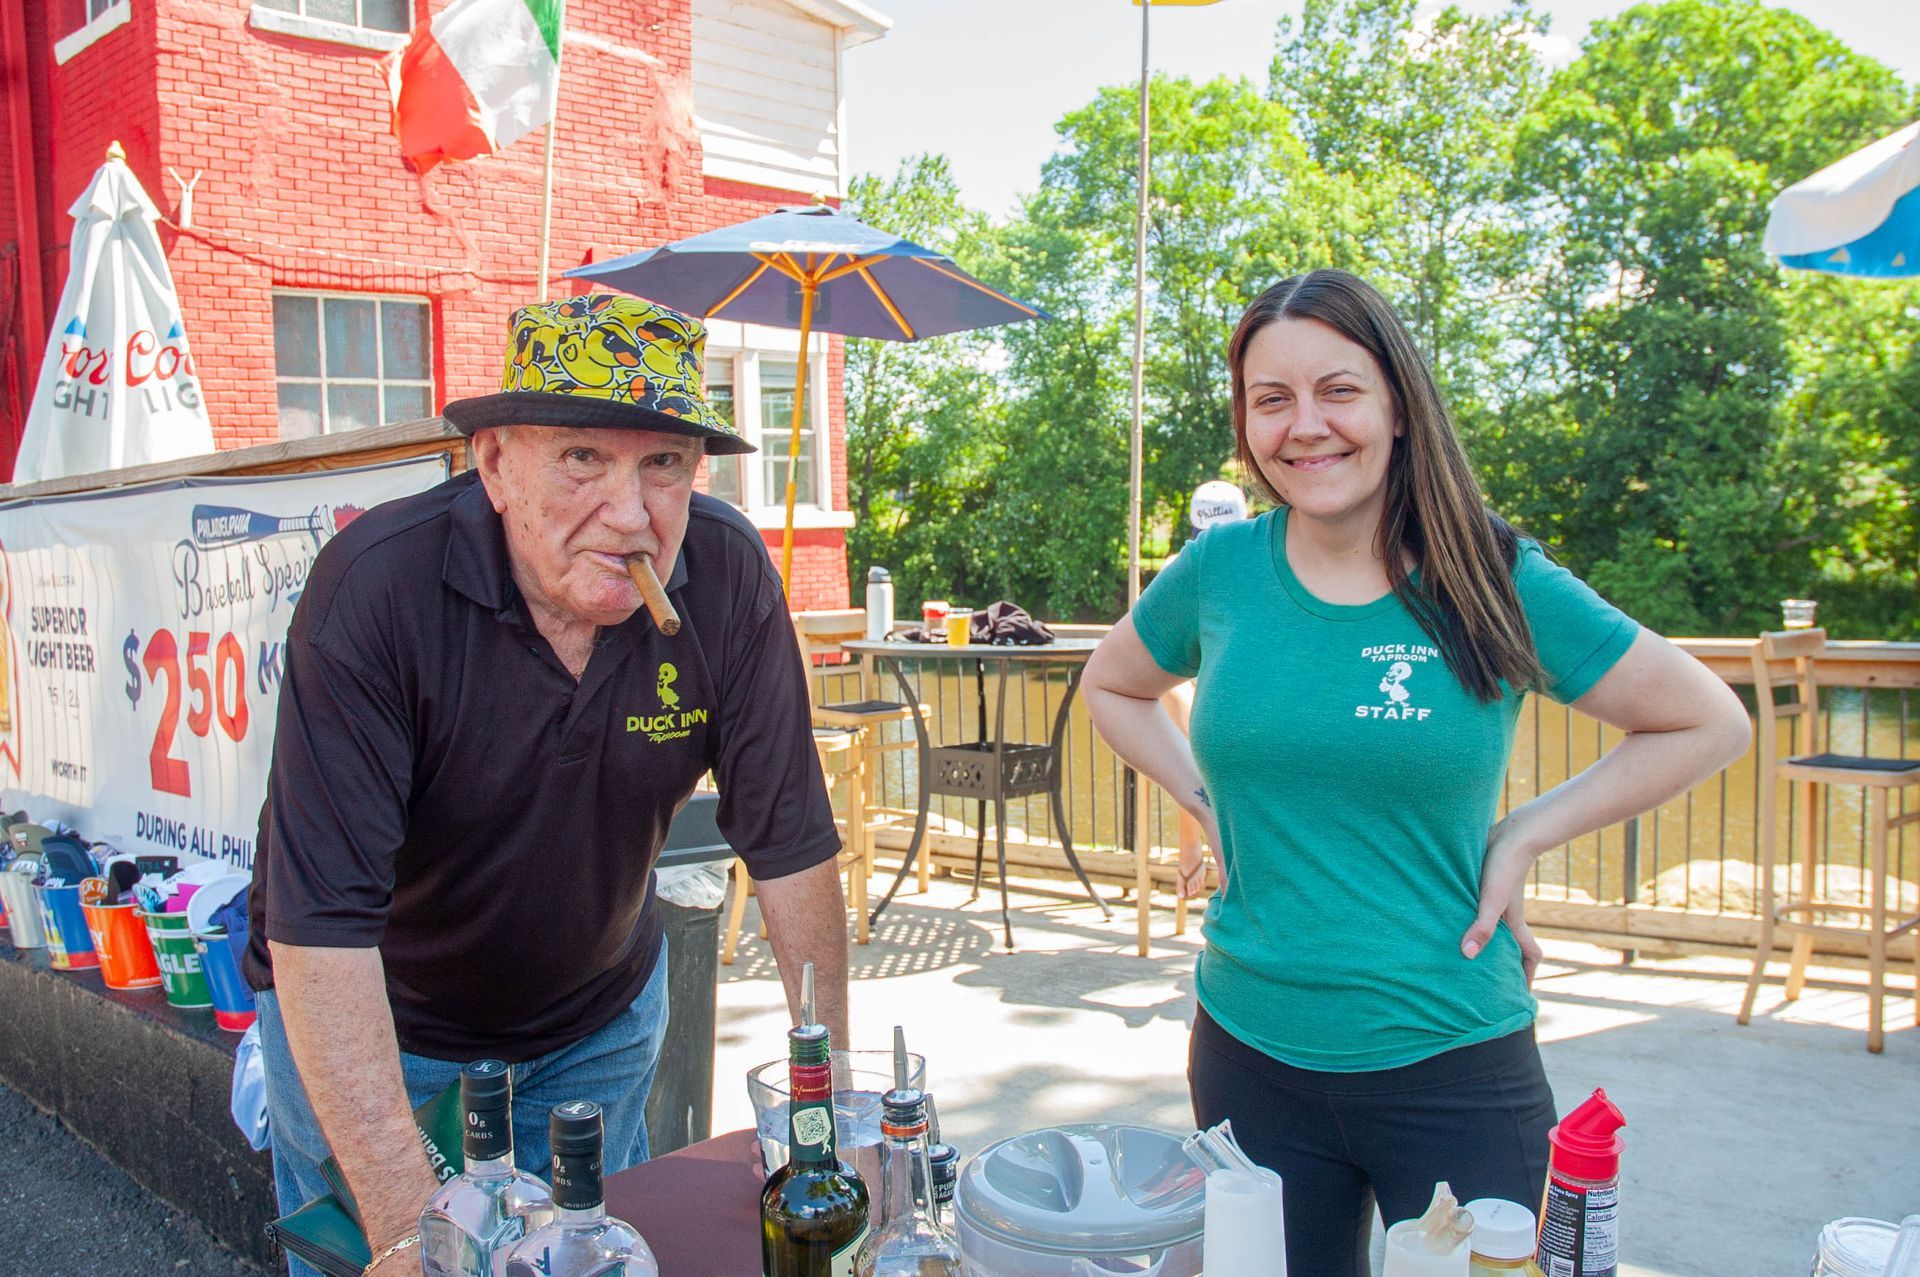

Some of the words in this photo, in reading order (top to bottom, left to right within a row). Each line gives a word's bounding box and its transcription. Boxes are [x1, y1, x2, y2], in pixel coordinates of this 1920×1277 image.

[196, 513, 251, 538] PHILADELPHIA
[173, 539, 255, 619] Baseball
[31, 607, 88, 636] SUPERIOR
[28, 641, 63, 669] LIGHT
[66, 644, 95, 673] BEER
[1361, 644, 1407, 658] DUCK
[1410, 645, 1438, 658] INN
[1371, 654, 1427, 663] TAPROOM
[626, 714, 675, 732] DUCK
[680, 708, 708, 728] INN
[1355, 705, 1432, 721] STAFF
[51, 758, 77, 781] WORTH
[80, 766, 87, 784] IT
[136, 811, 187, 850] DURING
[190, 826, 217, 859] ALL
[465, 1130, 493, 1139] CARBS
[1587, 1189, 1614, 1198] Nutrition
[1586, 1212, 1612, 1221] Calories
